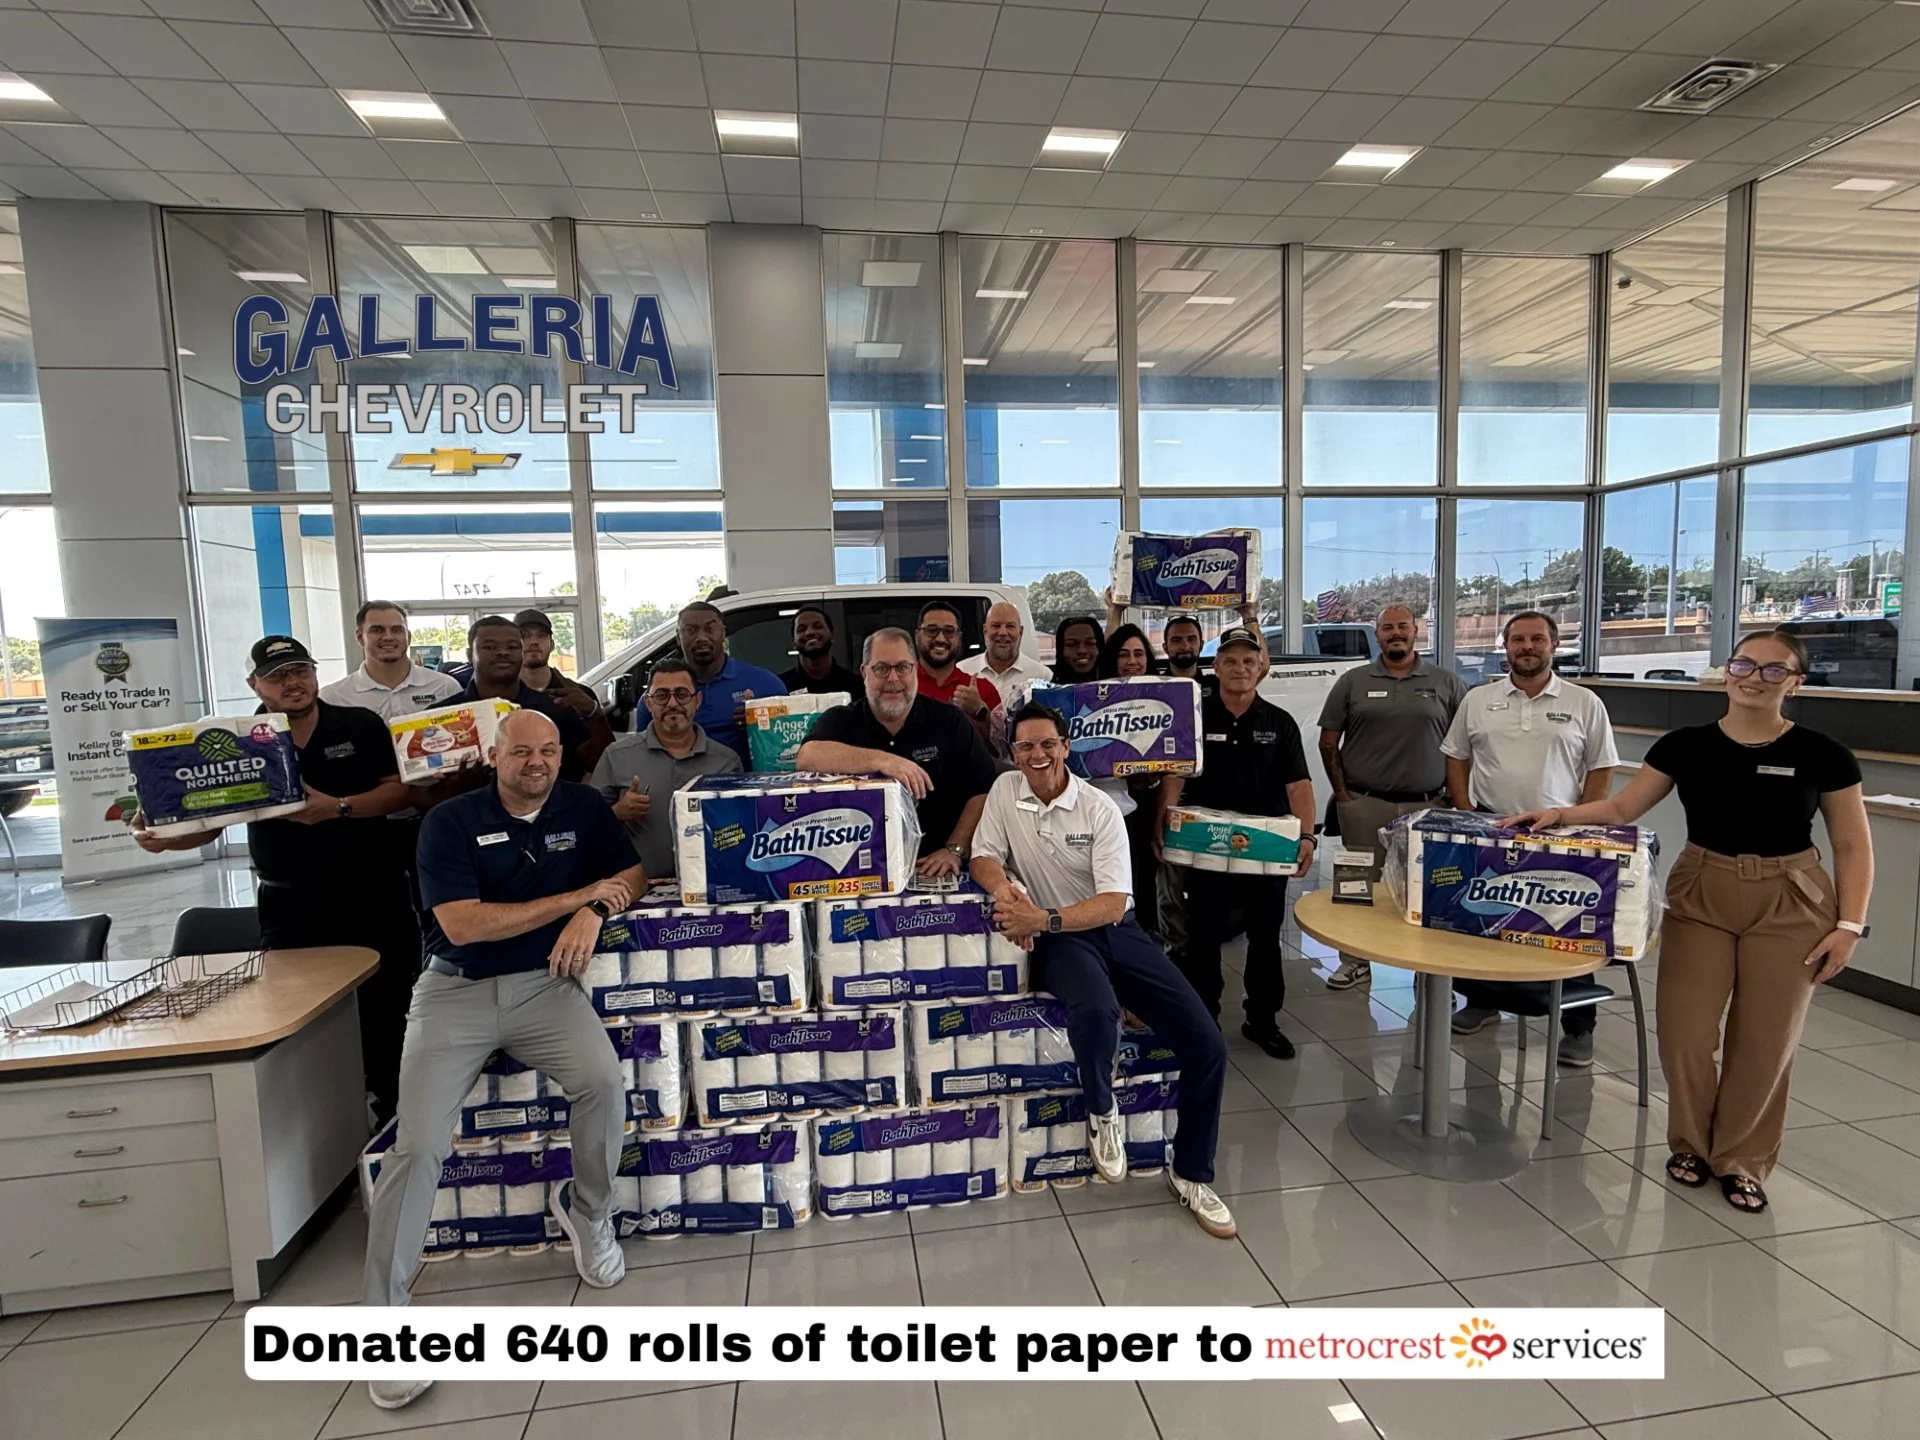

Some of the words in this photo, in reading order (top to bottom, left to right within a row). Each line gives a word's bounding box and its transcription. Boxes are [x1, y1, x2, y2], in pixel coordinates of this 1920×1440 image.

[1212, 596, 1227, 604] 235
[1279, 668, 1337, 679] BISON
[61, 690, 102, 702] Ready
[104, 690, 118, 700] to
[119, 688, 156, 698] Trade
[158, 686, 170, 697] In
[63, 704, 78, 713] or
[80, 701, 107, 712] Sell
[108, 700, 138, 710] Your
[141, 698, 170, 708] Car?
[773, 716, 810, 734] Angel
[137, 737, 148, 745] 18
[163, 734, 177, 742] 72
[782, 730, 806, 743] Soft
[79, 741, 110, 750] Kelley
[68, 750, 110, 762] Instant
[175, 757, 267, 780] QUILTED
[1116, 764, 1132, 774] 45
[186, 770, 261, 789] NORTHERN
[810, 816, 842, 825] Premium
[1207, 824, 1232, 834] Angel
[1212, 831, 1229, 842] Soft
[792, 884, 810, 896] 45
[838, 880, 860, 893] 235
[1505, 932, 1523, 944] 45
[1554, 940, 1579, 952] 235
